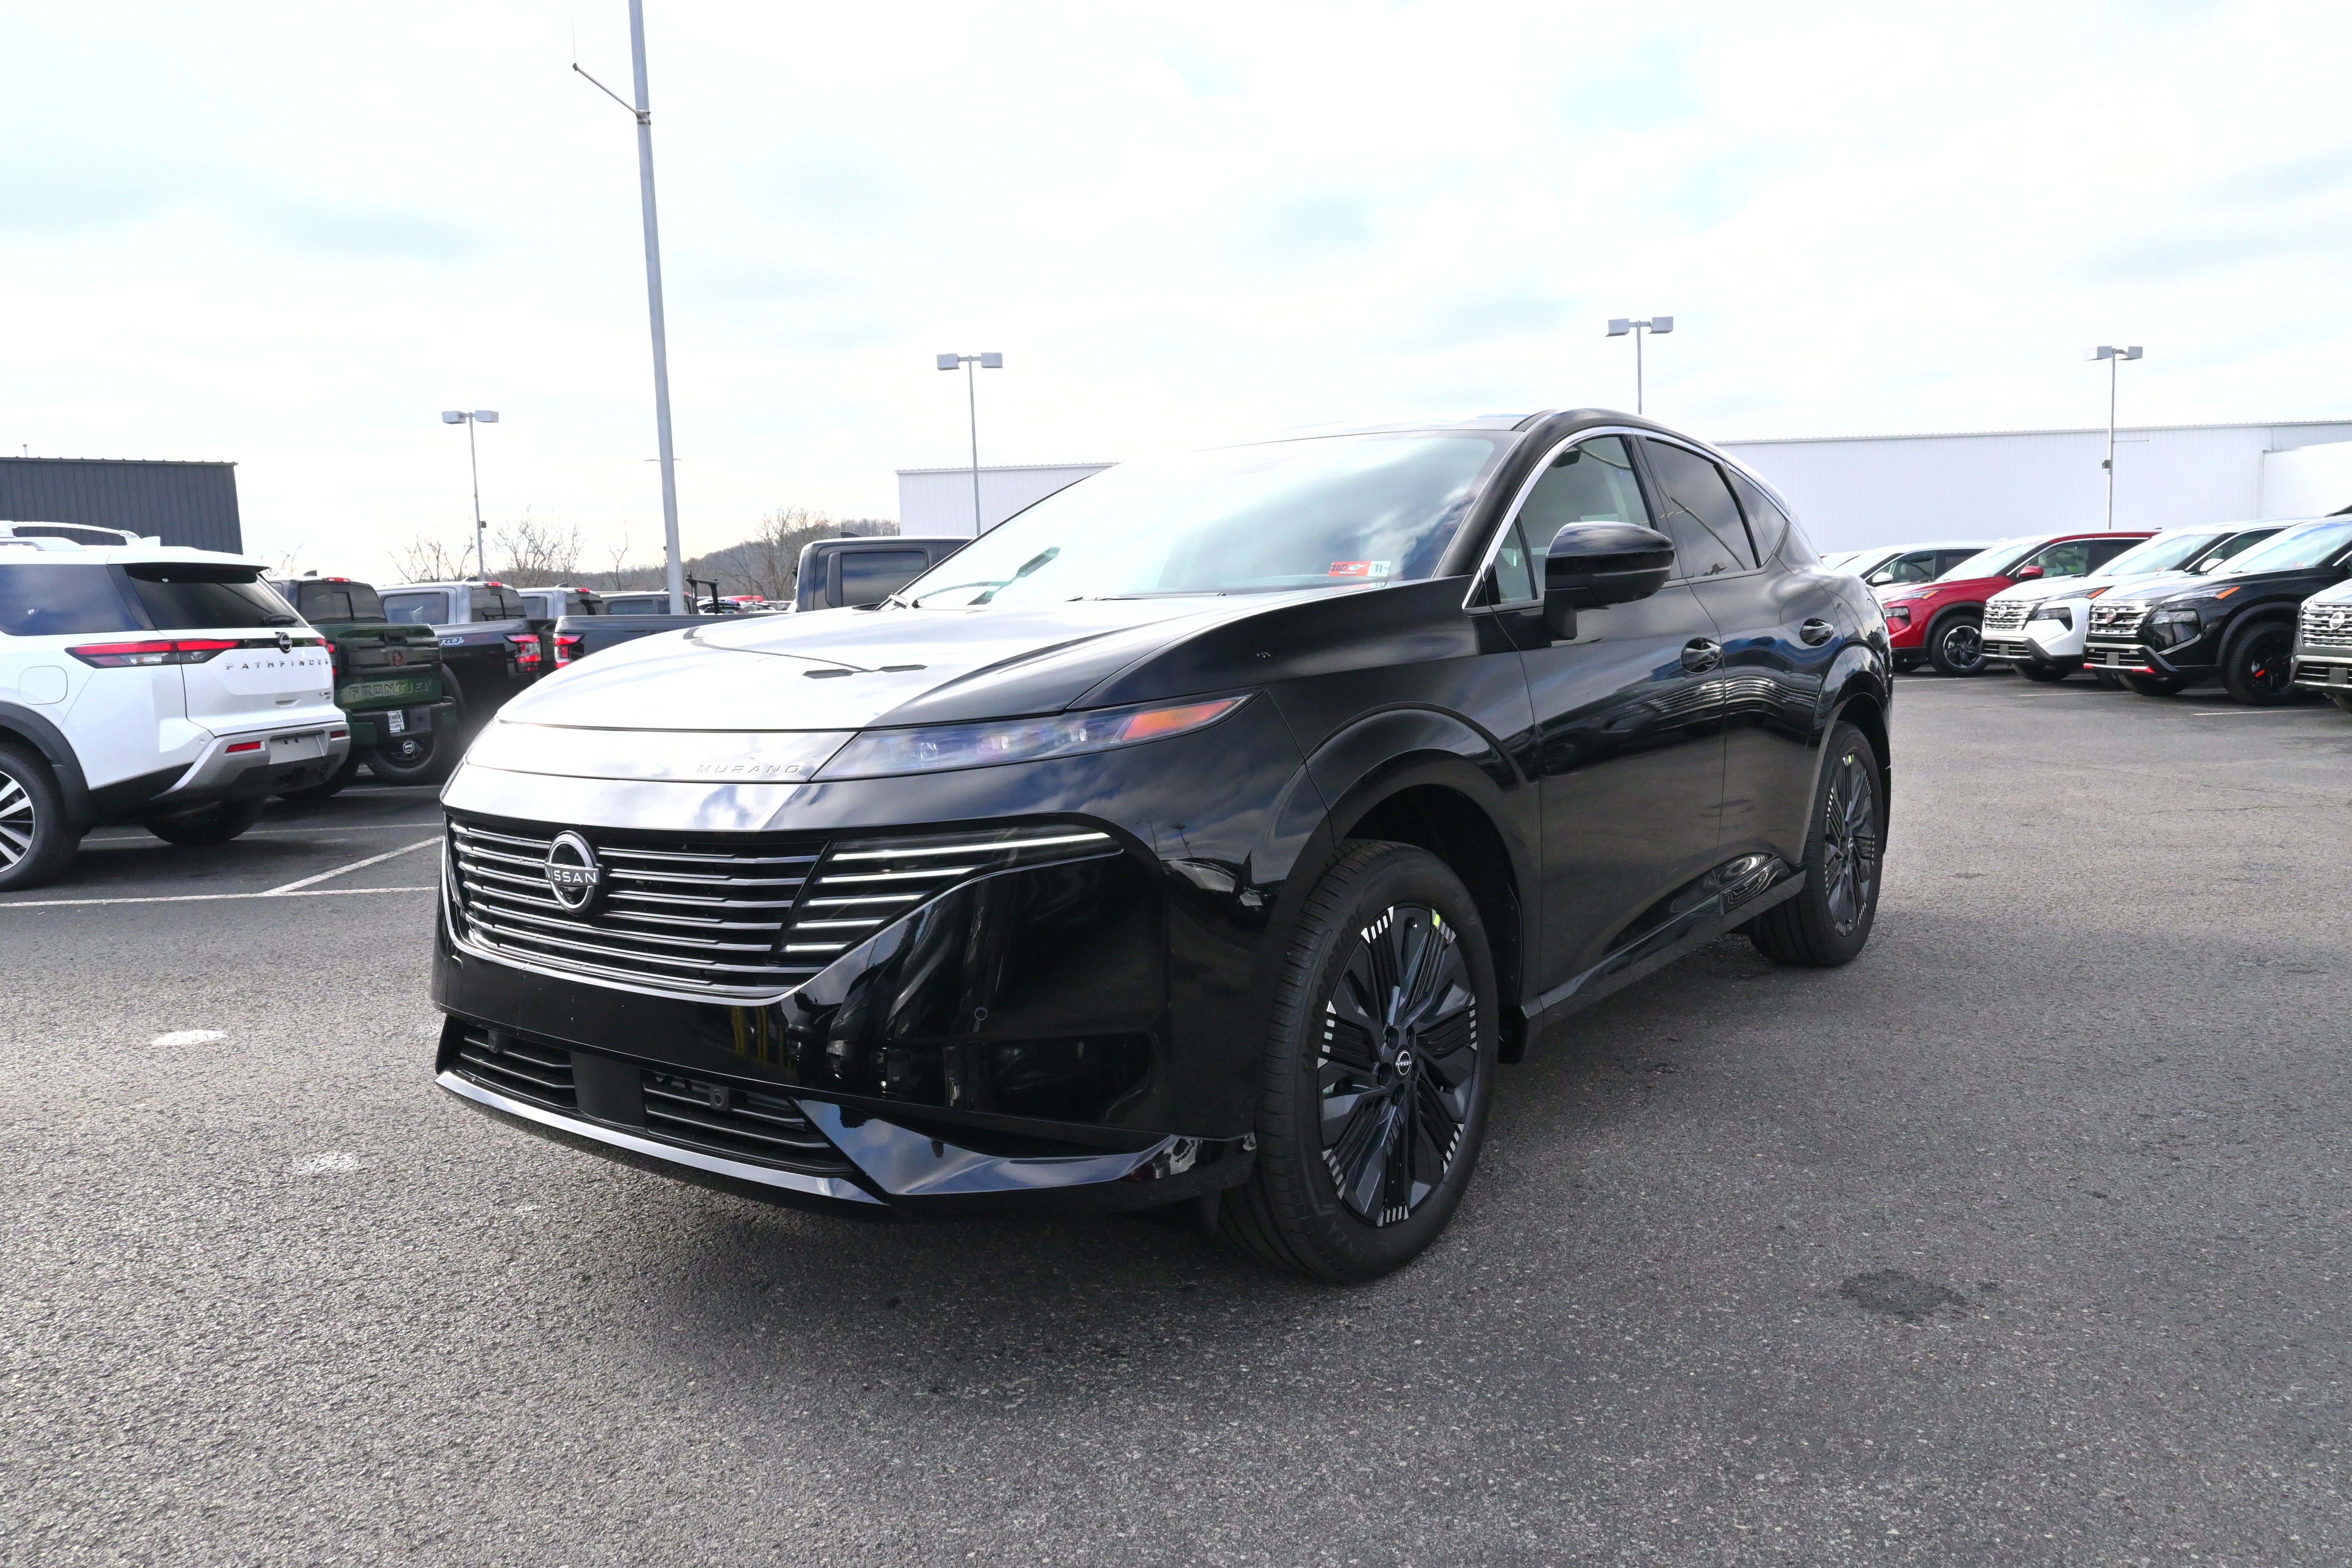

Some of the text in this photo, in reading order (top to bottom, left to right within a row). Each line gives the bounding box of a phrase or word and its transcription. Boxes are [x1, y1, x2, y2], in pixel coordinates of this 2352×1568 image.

[1375, 564, 1383, 572] 11
[226, 658, 328, 670] PATHFINDER
[697, 765, 800, 773] MURANO
[544, 866, 596, 883] NISSAN
